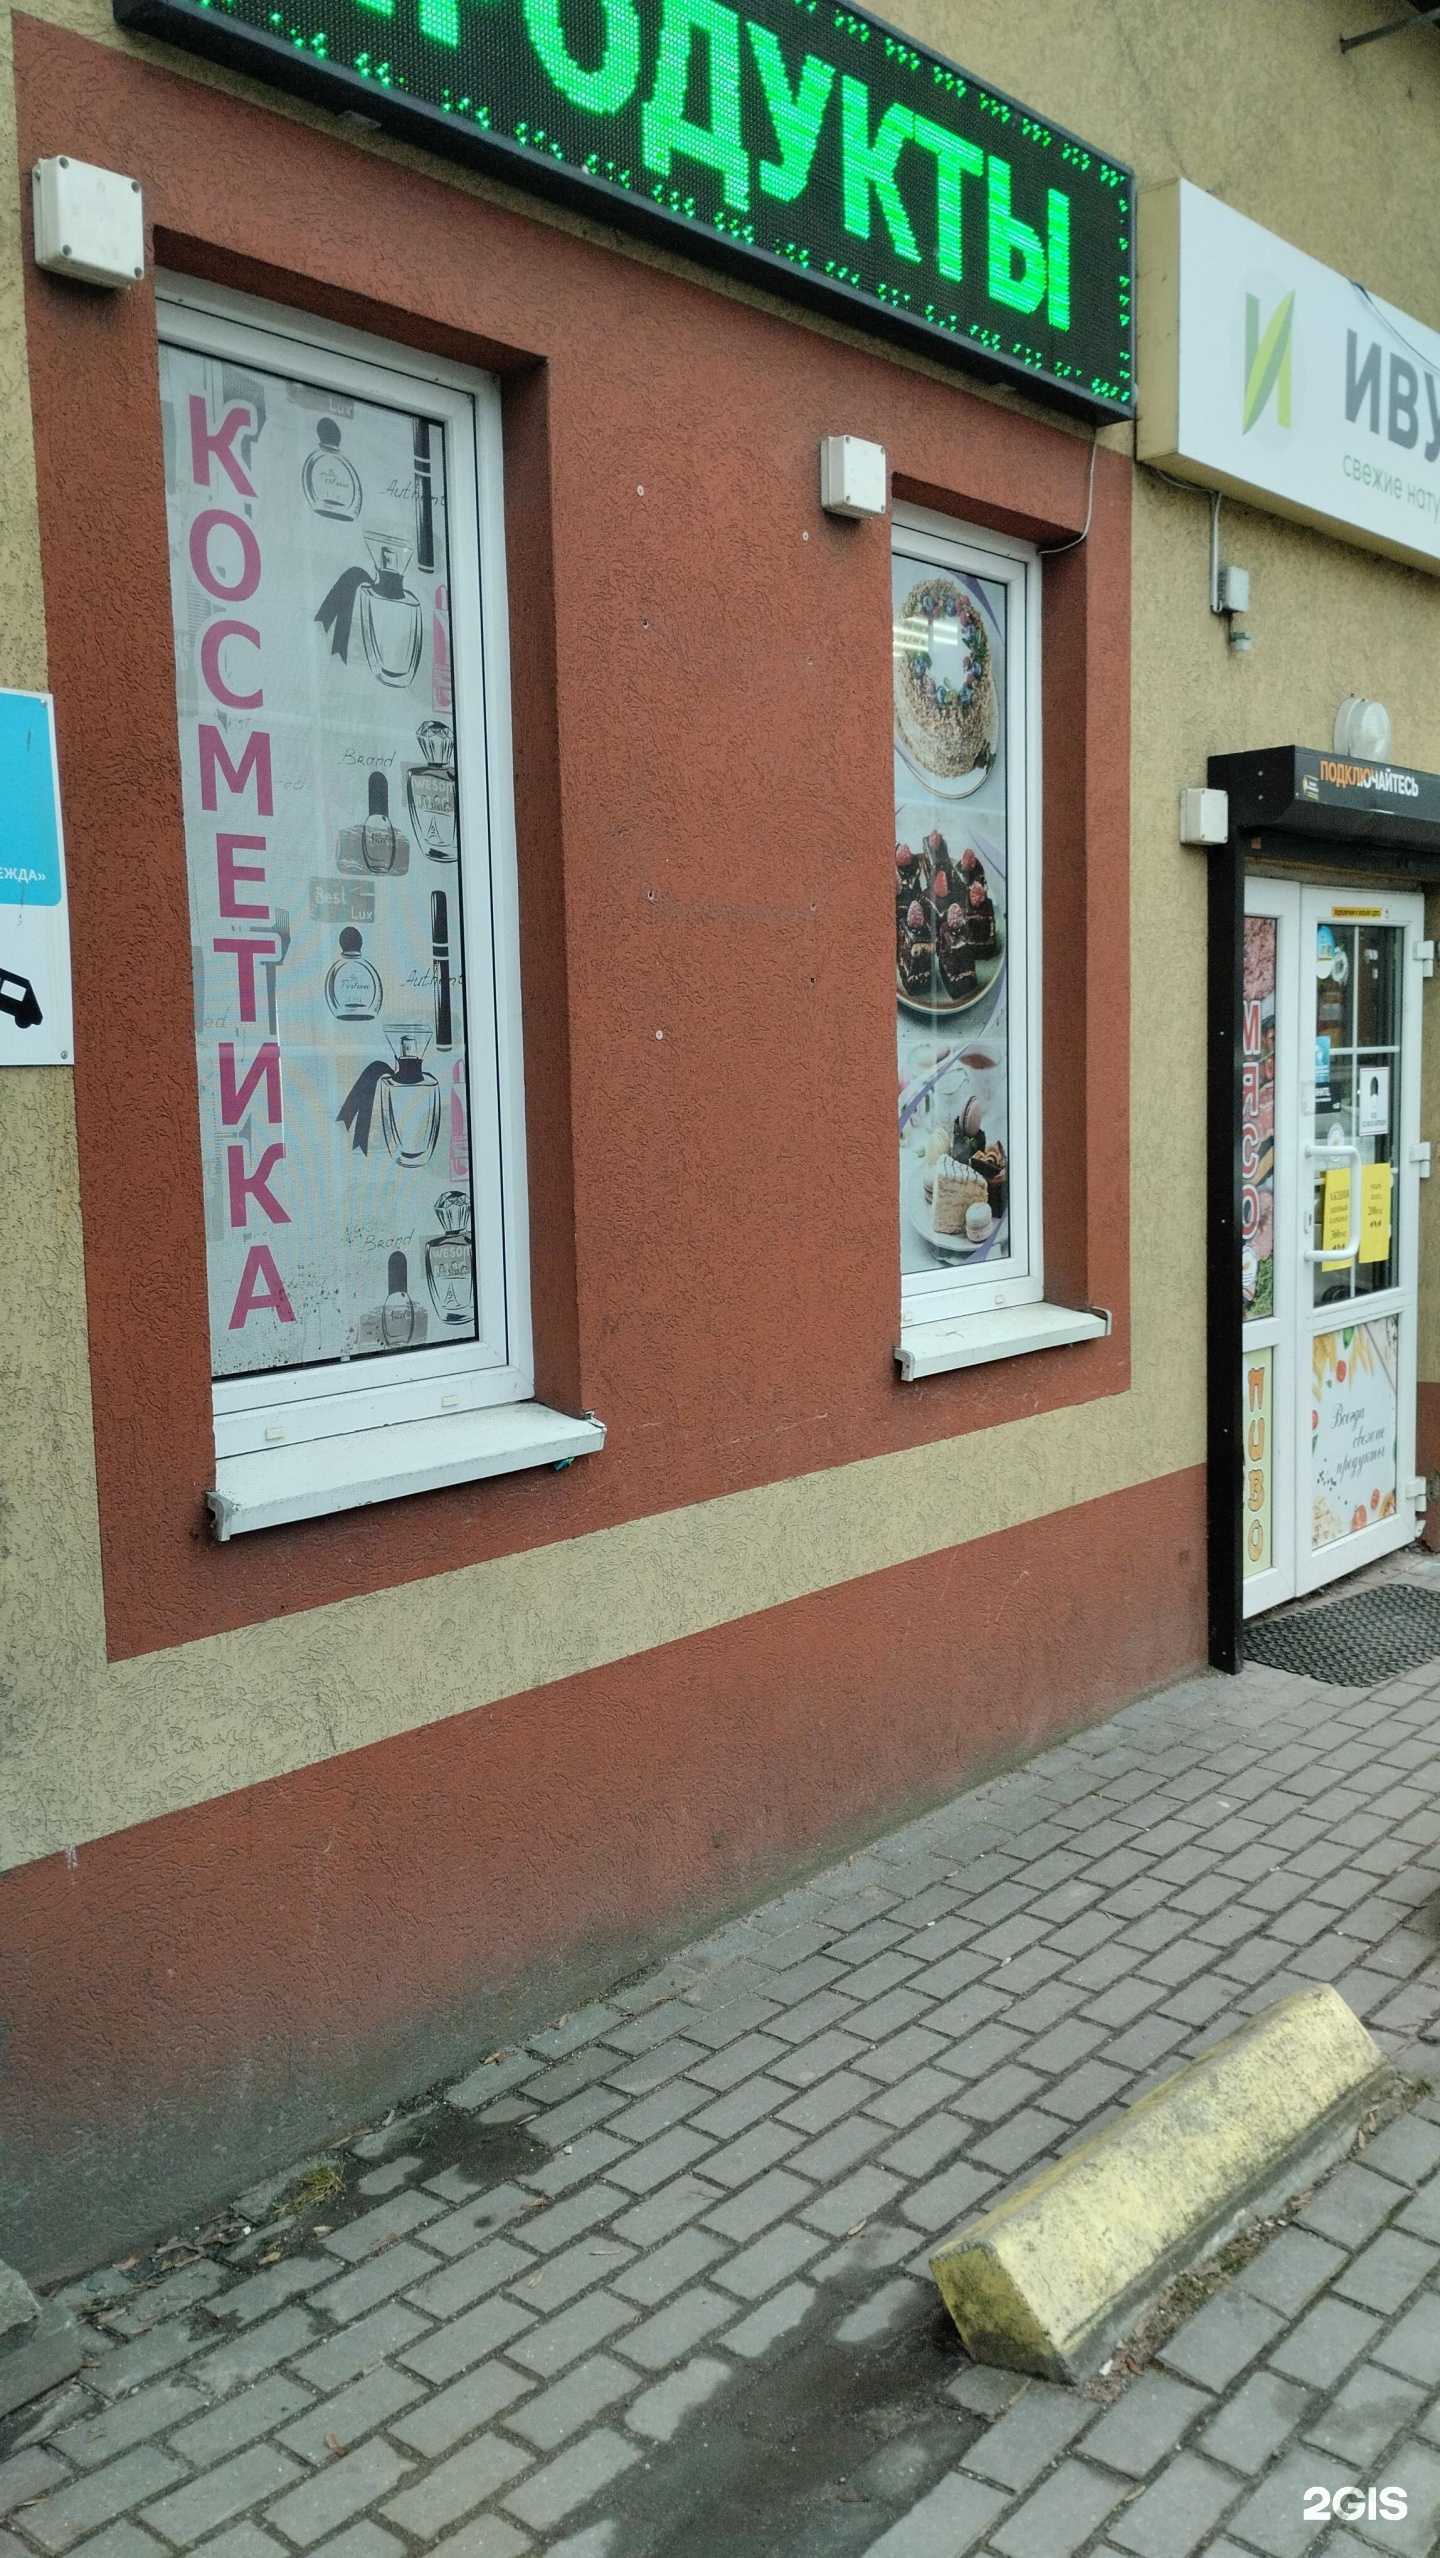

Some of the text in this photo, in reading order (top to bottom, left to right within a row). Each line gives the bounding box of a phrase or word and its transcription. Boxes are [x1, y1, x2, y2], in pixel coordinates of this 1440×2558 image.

[355, 0, 1069, 331] ОДУКТЫ
[1342, 454, 1403, 500] свежие
[188, 394, 297, 1329] КОСМЕТИКА
[1319, 760, 1419, 797] ПОДКЛЮЧАЙТЕСЬ
